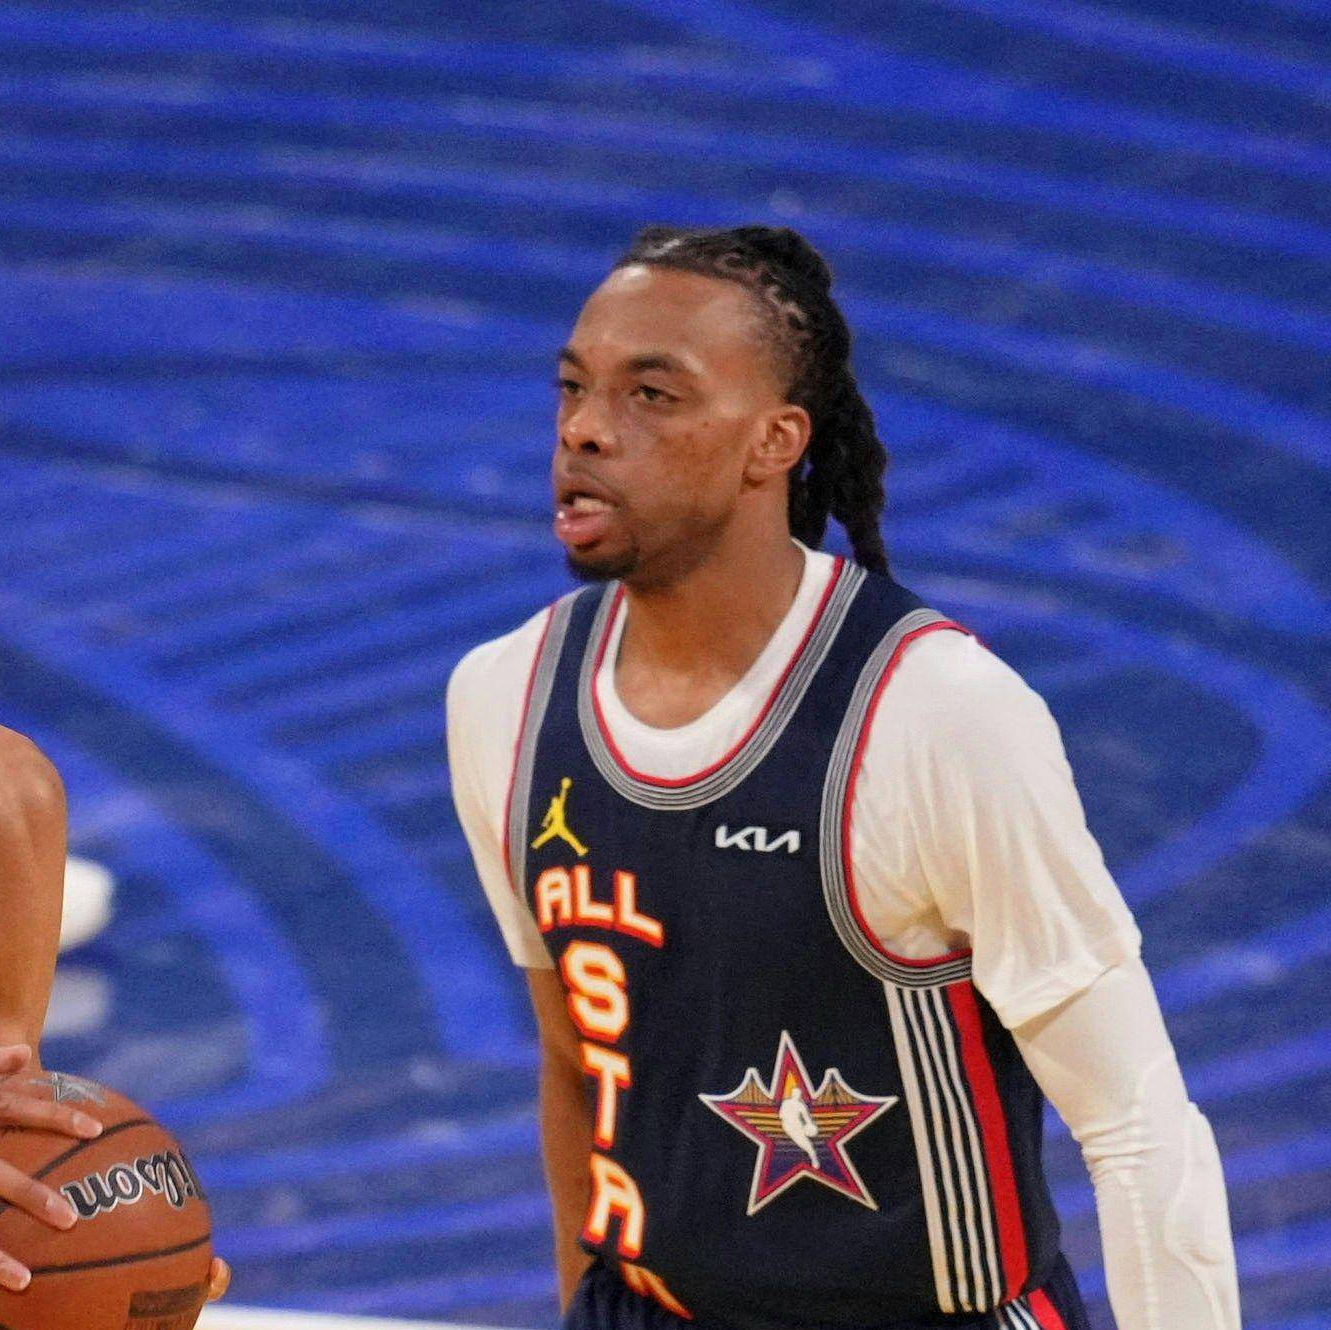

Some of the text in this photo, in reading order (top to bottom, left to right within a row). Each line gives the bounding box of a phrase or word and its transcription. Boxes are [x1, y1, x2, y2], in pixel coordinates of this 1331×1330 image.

[715, 825, 801, 854] KIA
[535, 864, 665, 949] ALL
[60, 1149, 205, 1219] ilson
